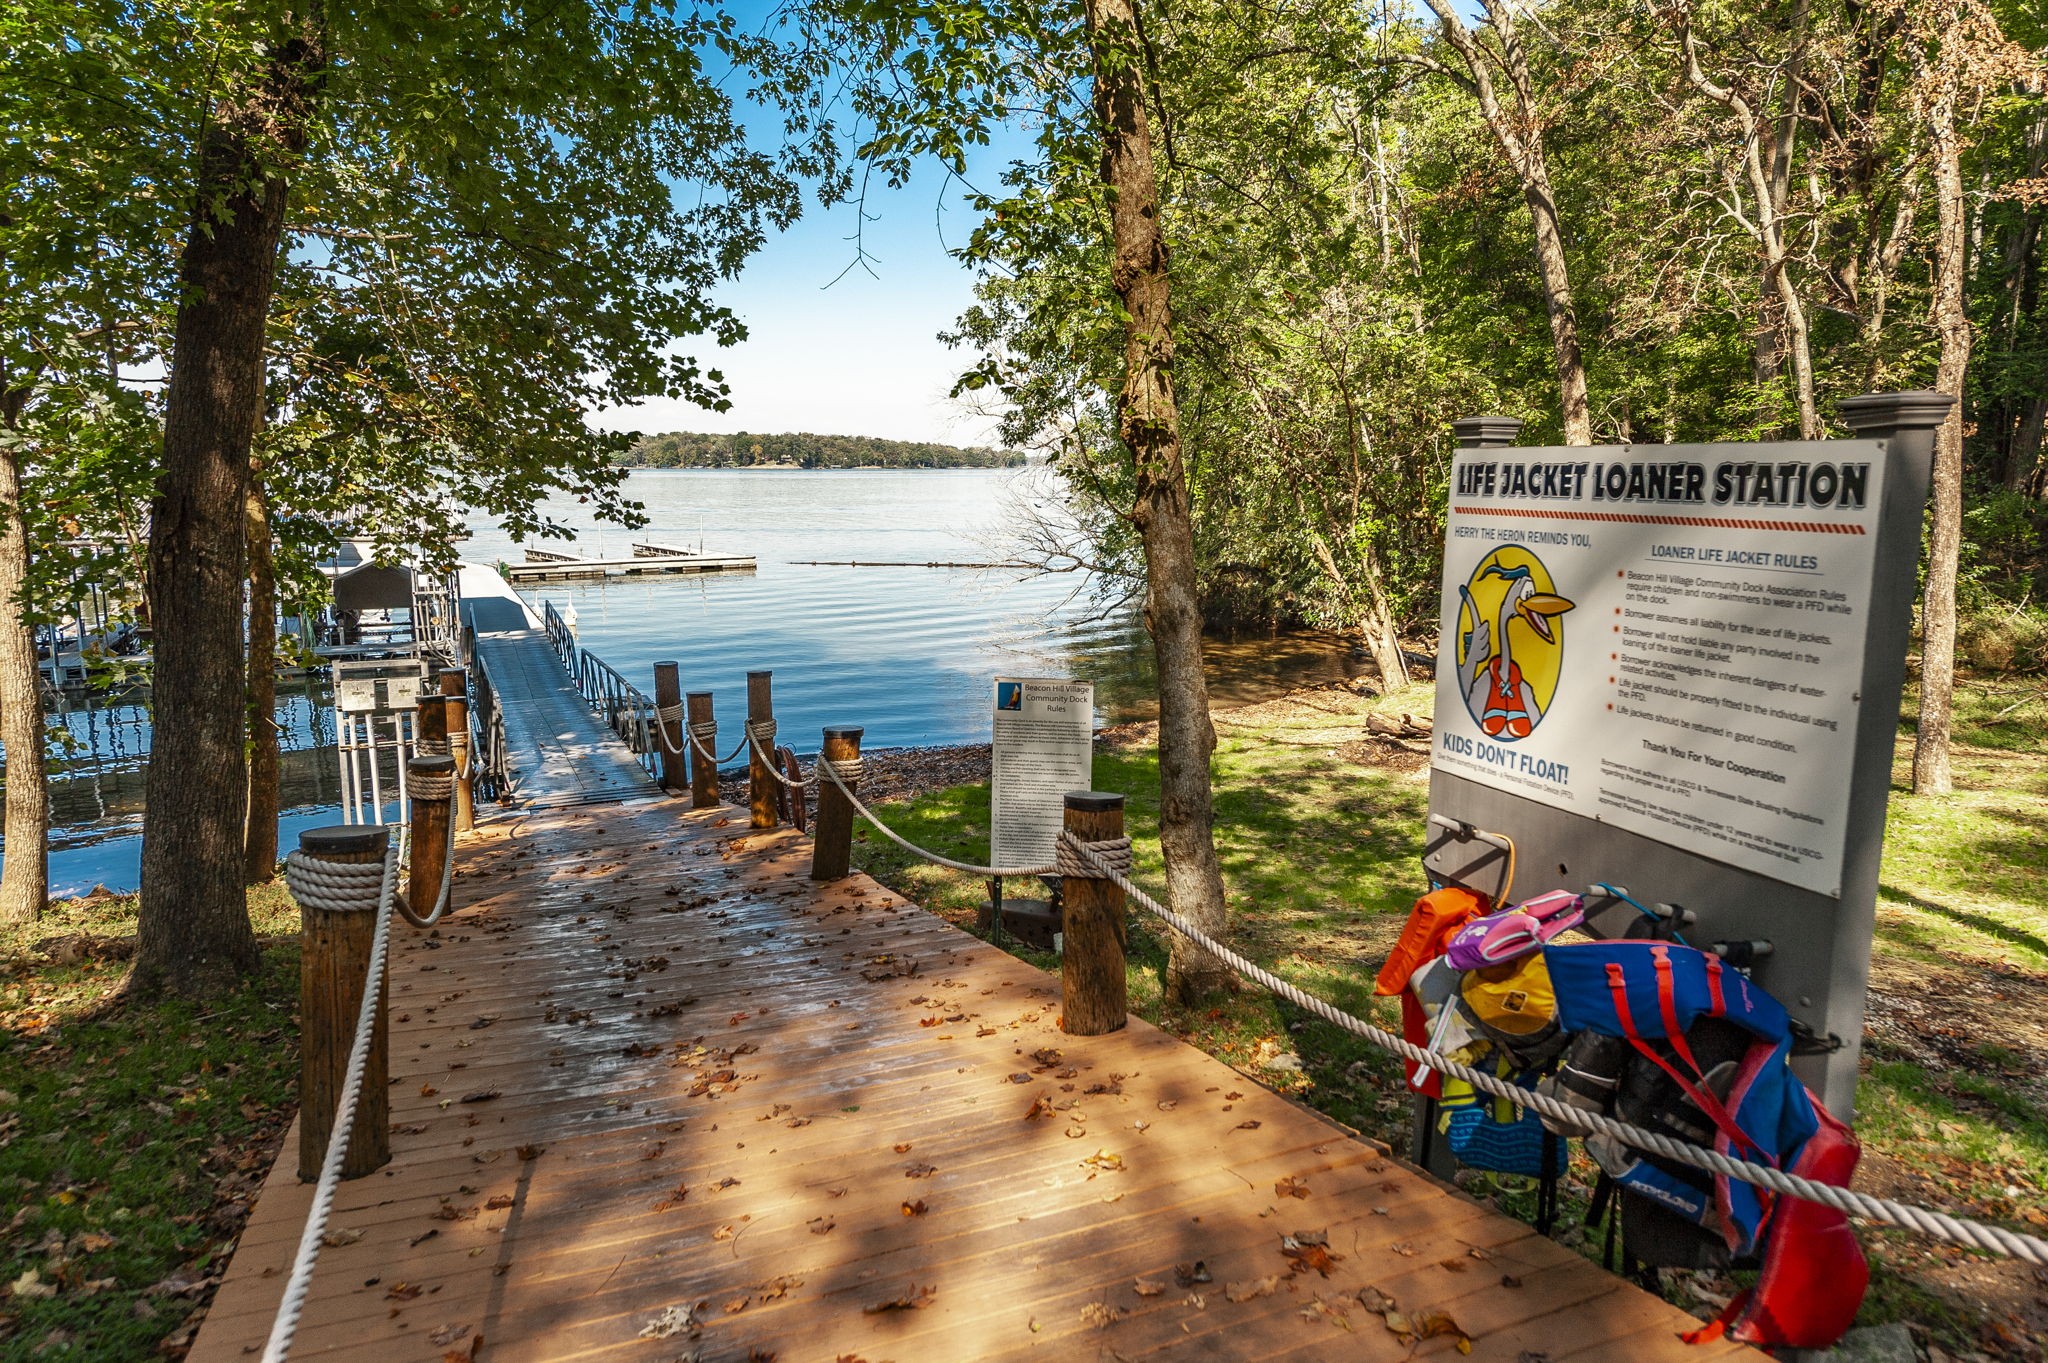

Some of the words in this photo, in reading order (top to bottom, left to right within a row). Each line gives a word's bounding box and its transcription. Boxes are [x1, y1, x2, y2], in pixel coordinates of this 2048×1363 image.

[1457, 462, 1498, 497] LIFE
[1499, 461, 1590, 500] JACKET
[1591, 461, 1706, 505] LOANER
[1711, 460, 1871, 510] STATION
[1454, 526, 1479, 538] HERRY
[1481, 527, 1495, 540] THE
[1497, 529, 1525, 542] HERON
[1527, 531, 1568, 545] REMINDS
[1571, 533, 1591, 548] YOU,
[1651, 544, 1695, 559] LOANER
[1698, 548, 1723, 562] LIFE
[1725, 550, 1771, 565] JACKET
[1774, 553, 1817, 570] RULES
[1626, 583, 1652, 592] require
[1653, 585, 1683, 595] children
[1684, 589, 1700, 597] and
[1701, 591, 1760, 604] non-swimmers
[1762, 596, 1771, 606] to
[1773, 599, 1795, 608] wear
[1804, 600, 1824, 611] PFD
[1826, 604, 1852, 614] while
[1627, 570, 1654, 581] Beacon
[1655, 573, 1668, 583] Hill
[1669, 575, 1694, 587] Village
[1695, 577, 1740, 592] Community
[1742, 581, 1764, 593] Dock
[1766, 584, 1817, 598] Association
[1819, 589, 1847, 602] Rules
[1636, 593, 1648, 602] the
[1649, 595, 1669, 605] dock.
[1624, 608, 1654, 620] Borrower
[1655, 614, 1688, 625] assumes
[1689, 617, 1698, 626] all
[1700, 618, 1726, 632] liability
[1727, 621, 1739, 632] for
[1740, 624, 1754, 634] the
[1755, 628, 1771, 637] use
[1772, 628, 1783, 638] of
[1783, 629, 1797, 640] life
[1798, 631, 1832, 645] jackets.
[1622, 638, 1647, 651] loaning
[1648, 642, 1655, 650] of
[1656, 643, 1668, 652] the
[1669, 645, 1693, 656] loaner
[1693, 649, 1705, 659] life
[1623, 625, 1653, 638] Borrower
[1654, 631, 1666, 640] will
[1667, 634, 1679, 643] not
[1681, 635, 1697, 645] hold
[1698, 637, 1719, 649] liable
[1720, 642, 1734, 653] any
[1735, 644, 1756, 656] party
[1758, 646, 1793, 660] involved
[1794, 652, 1803, 661] in
[1804, 653, 1820, 664] the
[1620, 664, 1644, 675] related
[1620, 653, 1650, 666] Borrower
[1651, 660, 1702, 676] acknowledges
[1704, 668, 1717, 678] the
[1718, 672, 1751, 685] inherent
[1752, 677, 1787, 691] dangers
[1788, 683, 1798, 692] of
[1026, 694, 1068, 703] Community
[1066, 685, 1089, 694] Village
[1617, 689, 1629, 698] the
[1618, 678, 1631, 688] Life
[1631, 681, 1653, 692] jacket
[1653, 685, 1678, 697] should
[1678, 689, 1689, 699] be
[1689, 693, 1720, 707] properly
[1721, 697, 1742, 710] fitted
[1743, 703, 1752, 712] to
[1753, 704, 1768, 715] the
[1769, 707, 1810, 724] individual
[1812, 718, 1837, 732] using
[1616, 705, 1629, 715] Life
[1629, 709, 1654, 721] jackets
[1654, 714, 1679, 726] should
[1680, 719, 1690, 729] be
[1691, 723, 1724, 736] returned
[1725, 728, 1733, 738] in
[1734, 732, 1755, 743] good
[1443, 732, 1473, 756] KIDS
[1476, 741, 1517, 769] DON'T
[1520, 753, 1568, 785] FLOAT!
[1642, 739, 1668, 754] Thank
[1669, 745, 1686, 759] You
[1687, 750, 1702, 762] For
[1704, 754, 1724, 768] Your
[1726, 760, 1786, 784] Cooperation
